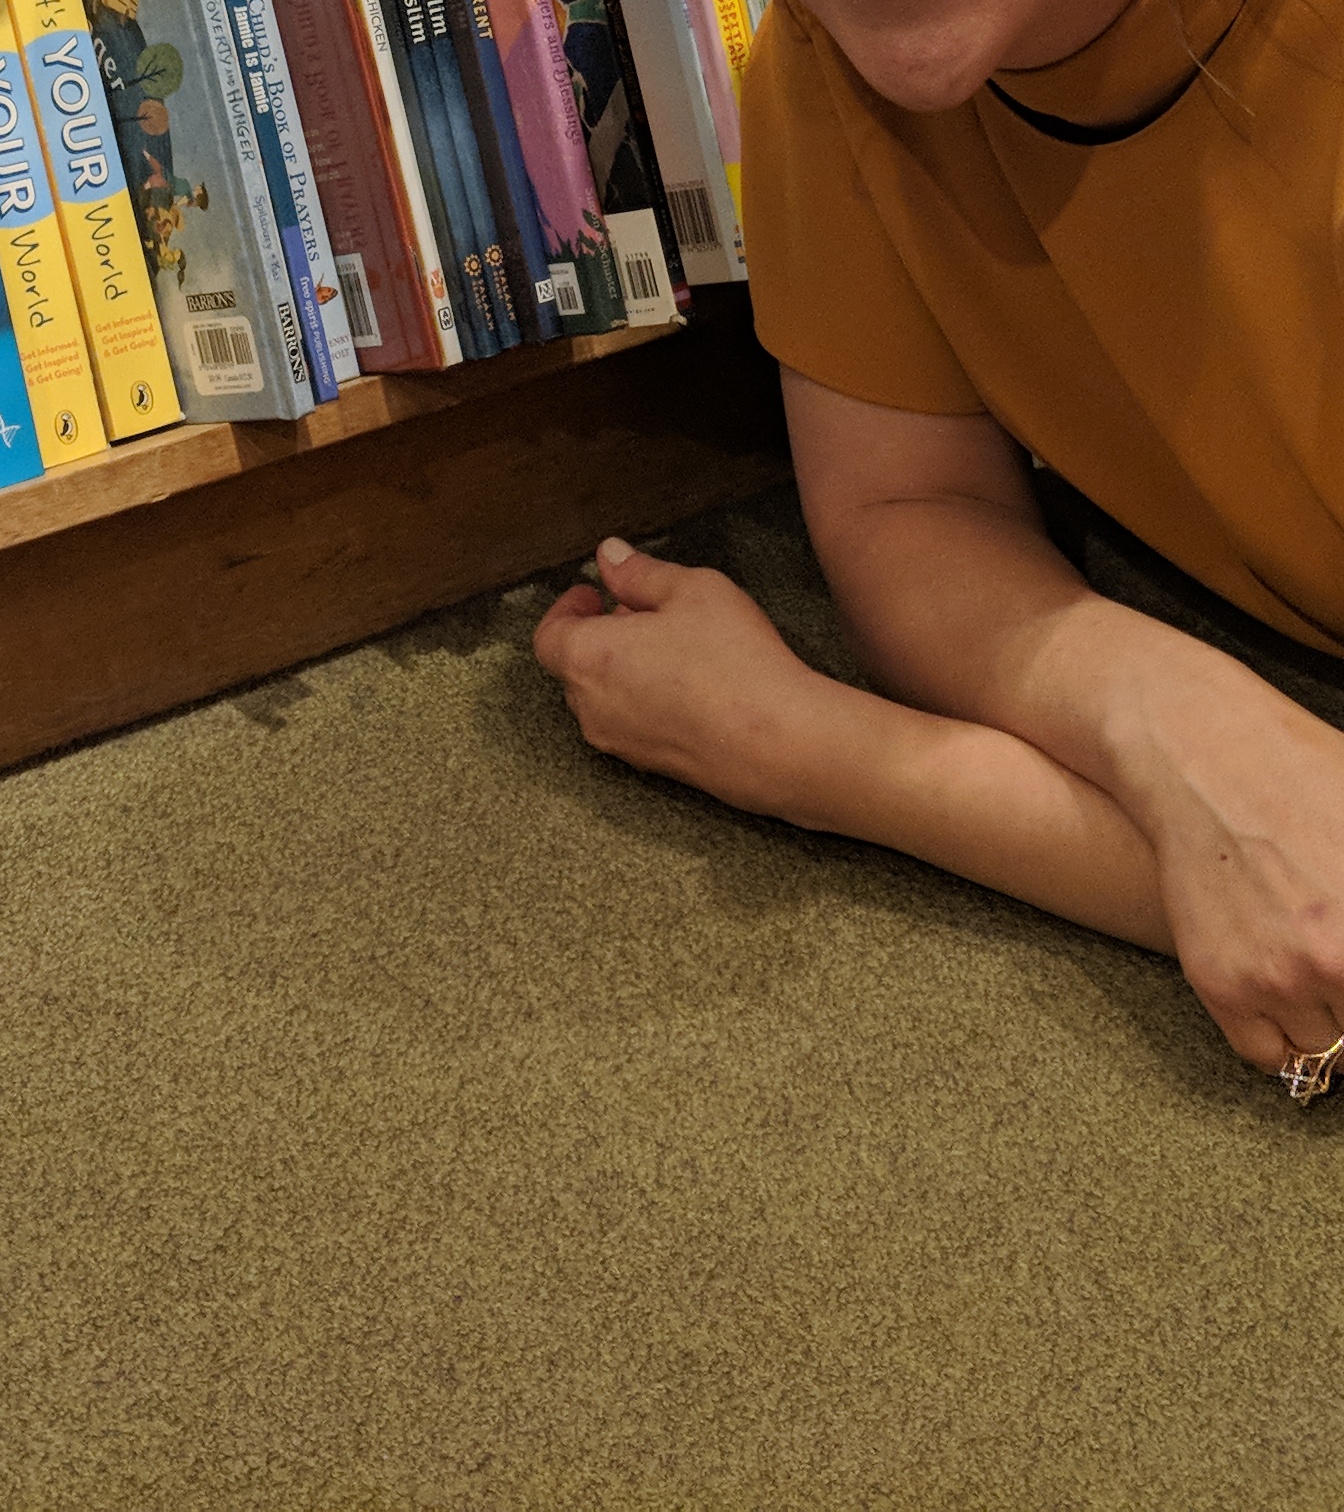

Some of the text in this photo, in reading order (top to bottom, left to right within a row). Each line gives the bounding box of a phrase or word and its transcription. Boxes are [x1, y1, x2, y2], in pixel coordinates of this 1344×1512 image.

[41, 35, 110, 194] YOUR
[10, 229, 54, 328] World
[84, 204, 128, 301] World
